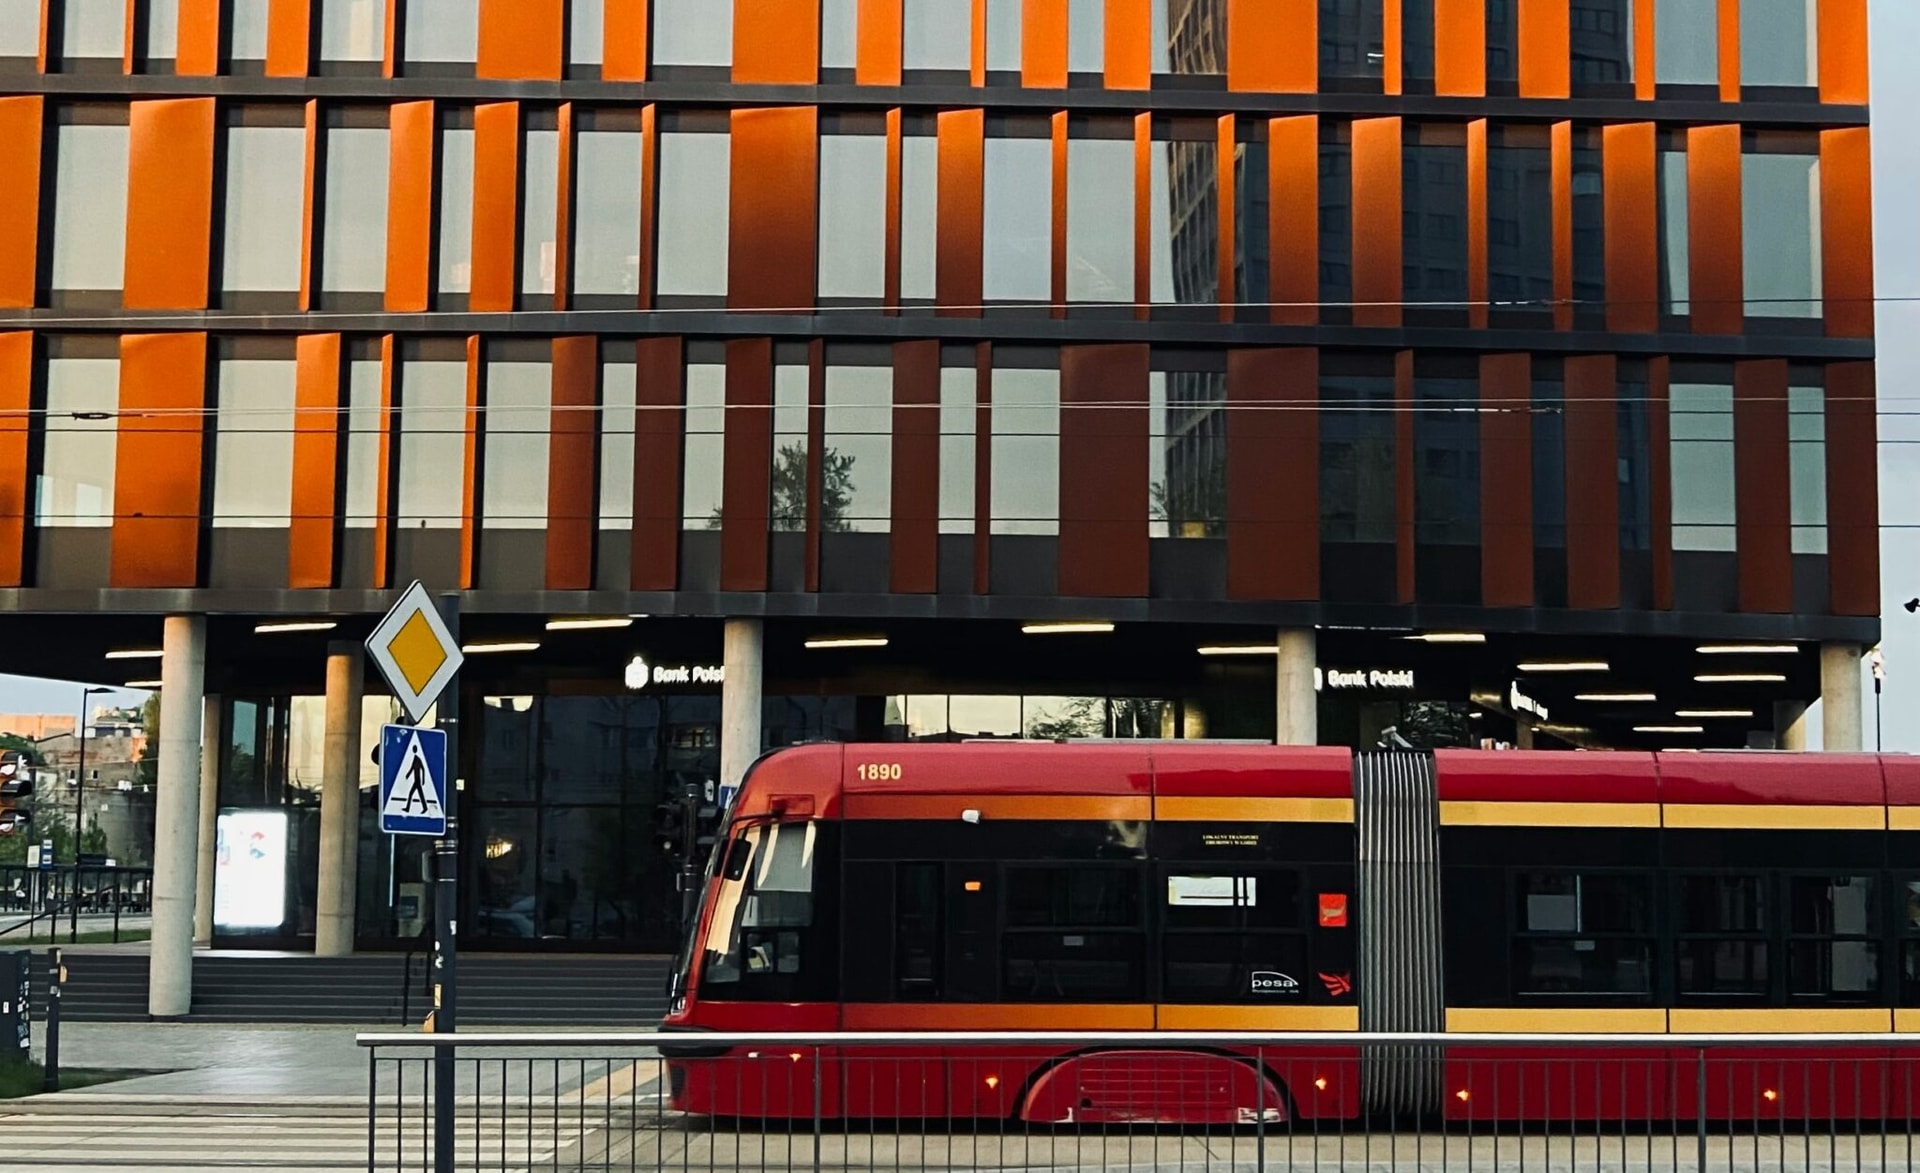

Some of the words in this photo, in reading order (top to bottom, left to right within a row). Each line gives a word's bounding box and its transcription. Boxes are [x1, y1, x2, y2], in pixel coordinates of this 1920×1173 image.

[653, 666, 689, 683] Bank
[1328, 669, 1367, 688] Bank
[1369, 669, 1414, 688] Polski
[857, 763, 902, 780] 1890
[1252, 979, 1294, 989] pesa
